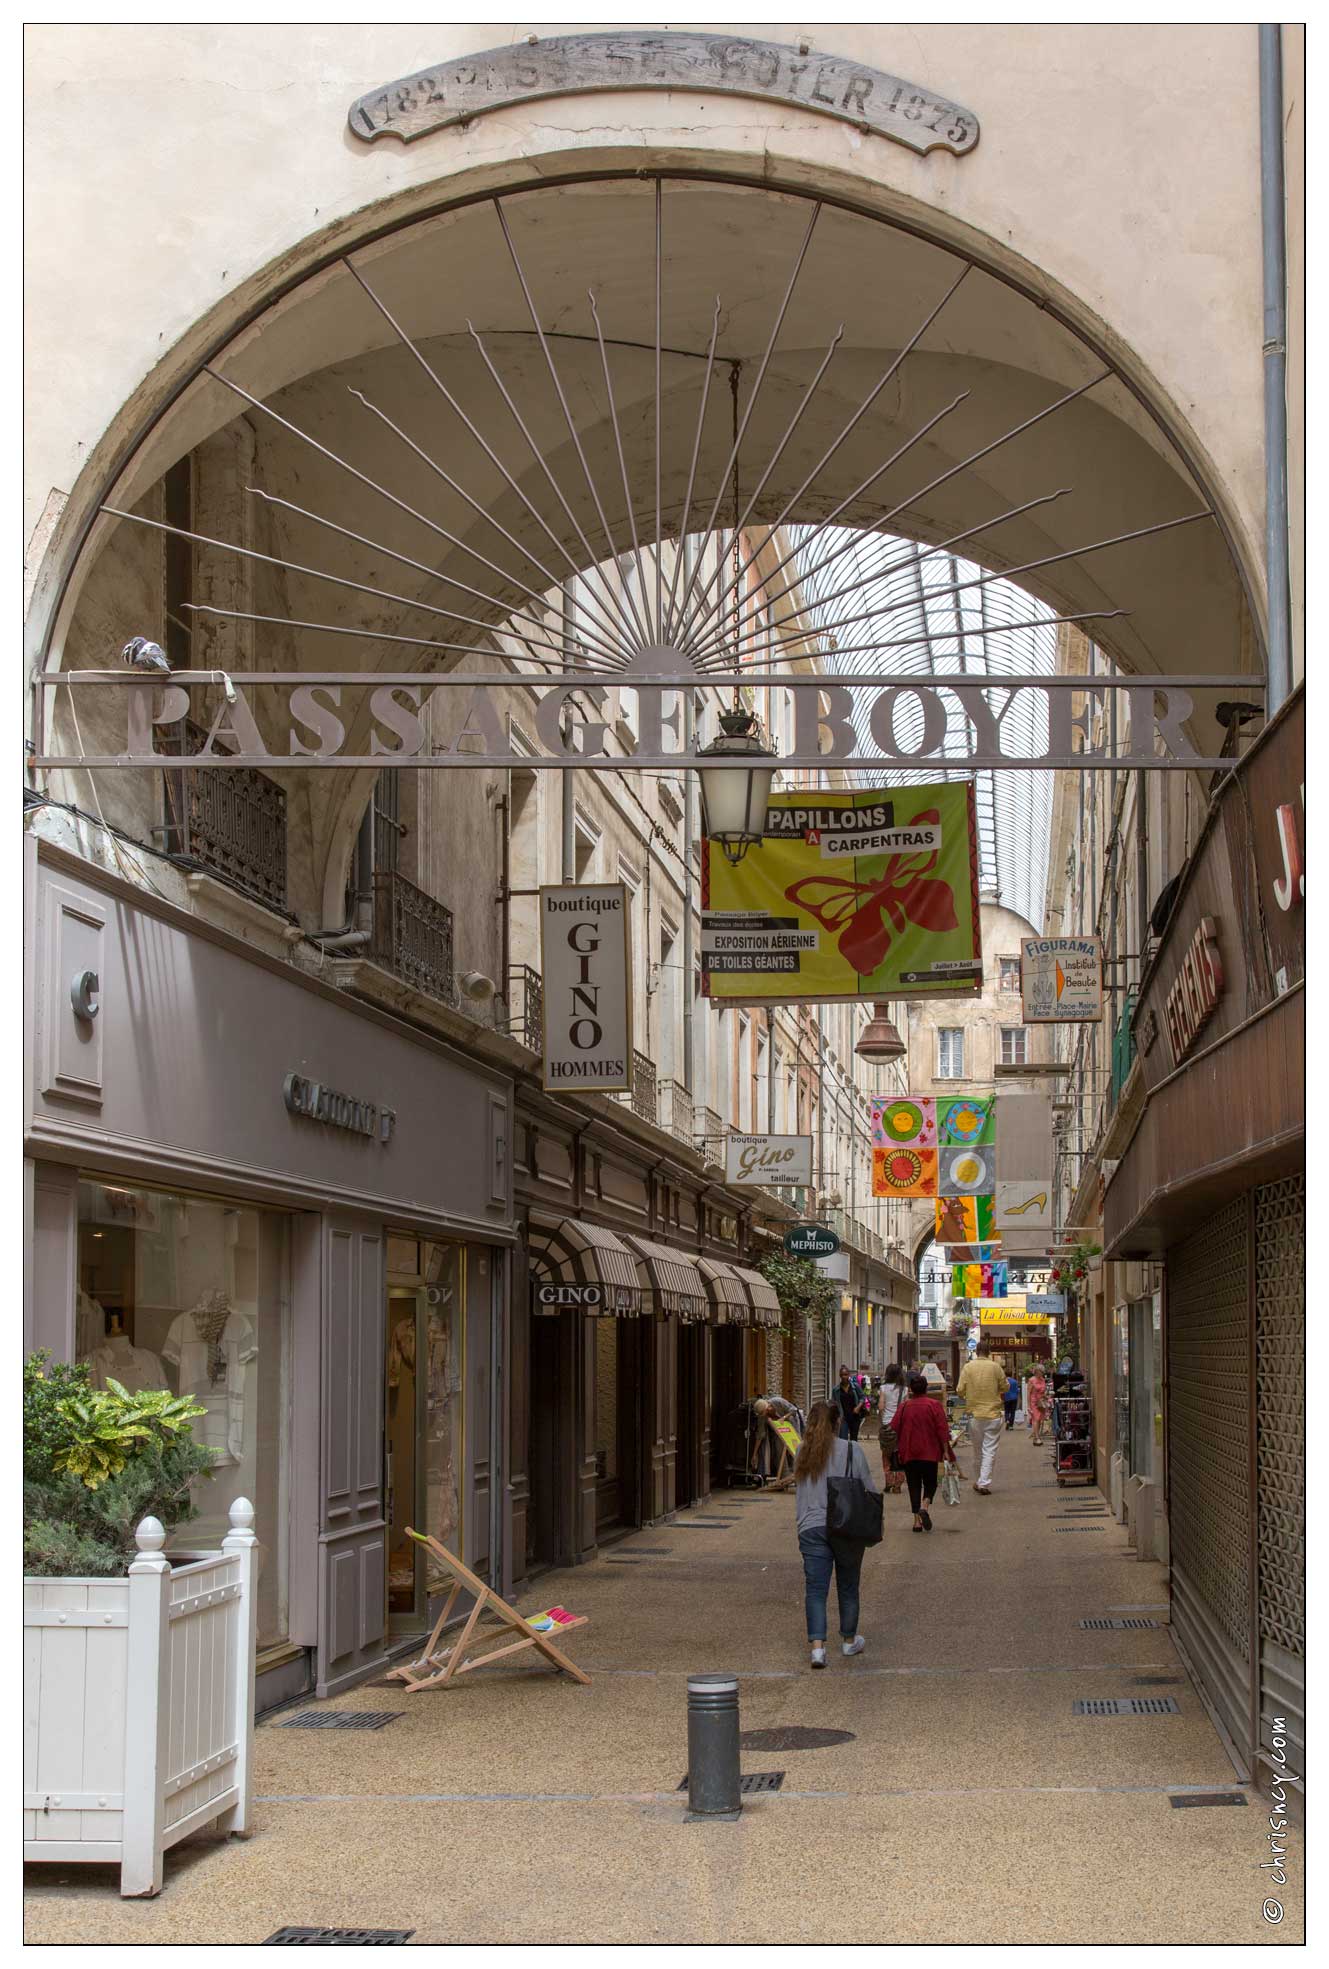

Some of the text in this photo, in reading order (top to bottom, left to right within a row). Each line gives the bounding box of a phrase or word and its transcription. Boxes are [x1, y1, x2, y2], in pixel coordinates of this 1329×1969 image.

[718, 46, 875, 115] BOYER
[885, 86, 973, 143] 1875
[119, 683, 1202, 759] PASSAGE BOYER
[767, 808, 886, 830] PAPILLONS
[827, 831, 935, 853] CARPENTRAS
[547, 896, 621, 915] boutique
[714, 932, 815, 949] EXPOSITION AÉRIENNE
[708, 953, 795, 968] DE TOILES GÉANTES
[1065, 959, 1096, 969] Institut
[566, 922, 603, 1050] GINO
[550, 1060, 624, 1078] HOMMES
[731, 1136, 768, 1145] boutique
[737, 1146, 795, 1180] Gino
[770, 1174, 800, 1183] tailleur
[790, 1240, 834, 1251] MEPHISTO
[538, 1286, 601, 1304] GINO
[984, 1309, 994, 1319] La
[999, 1309, 1025, 1319] Toison
